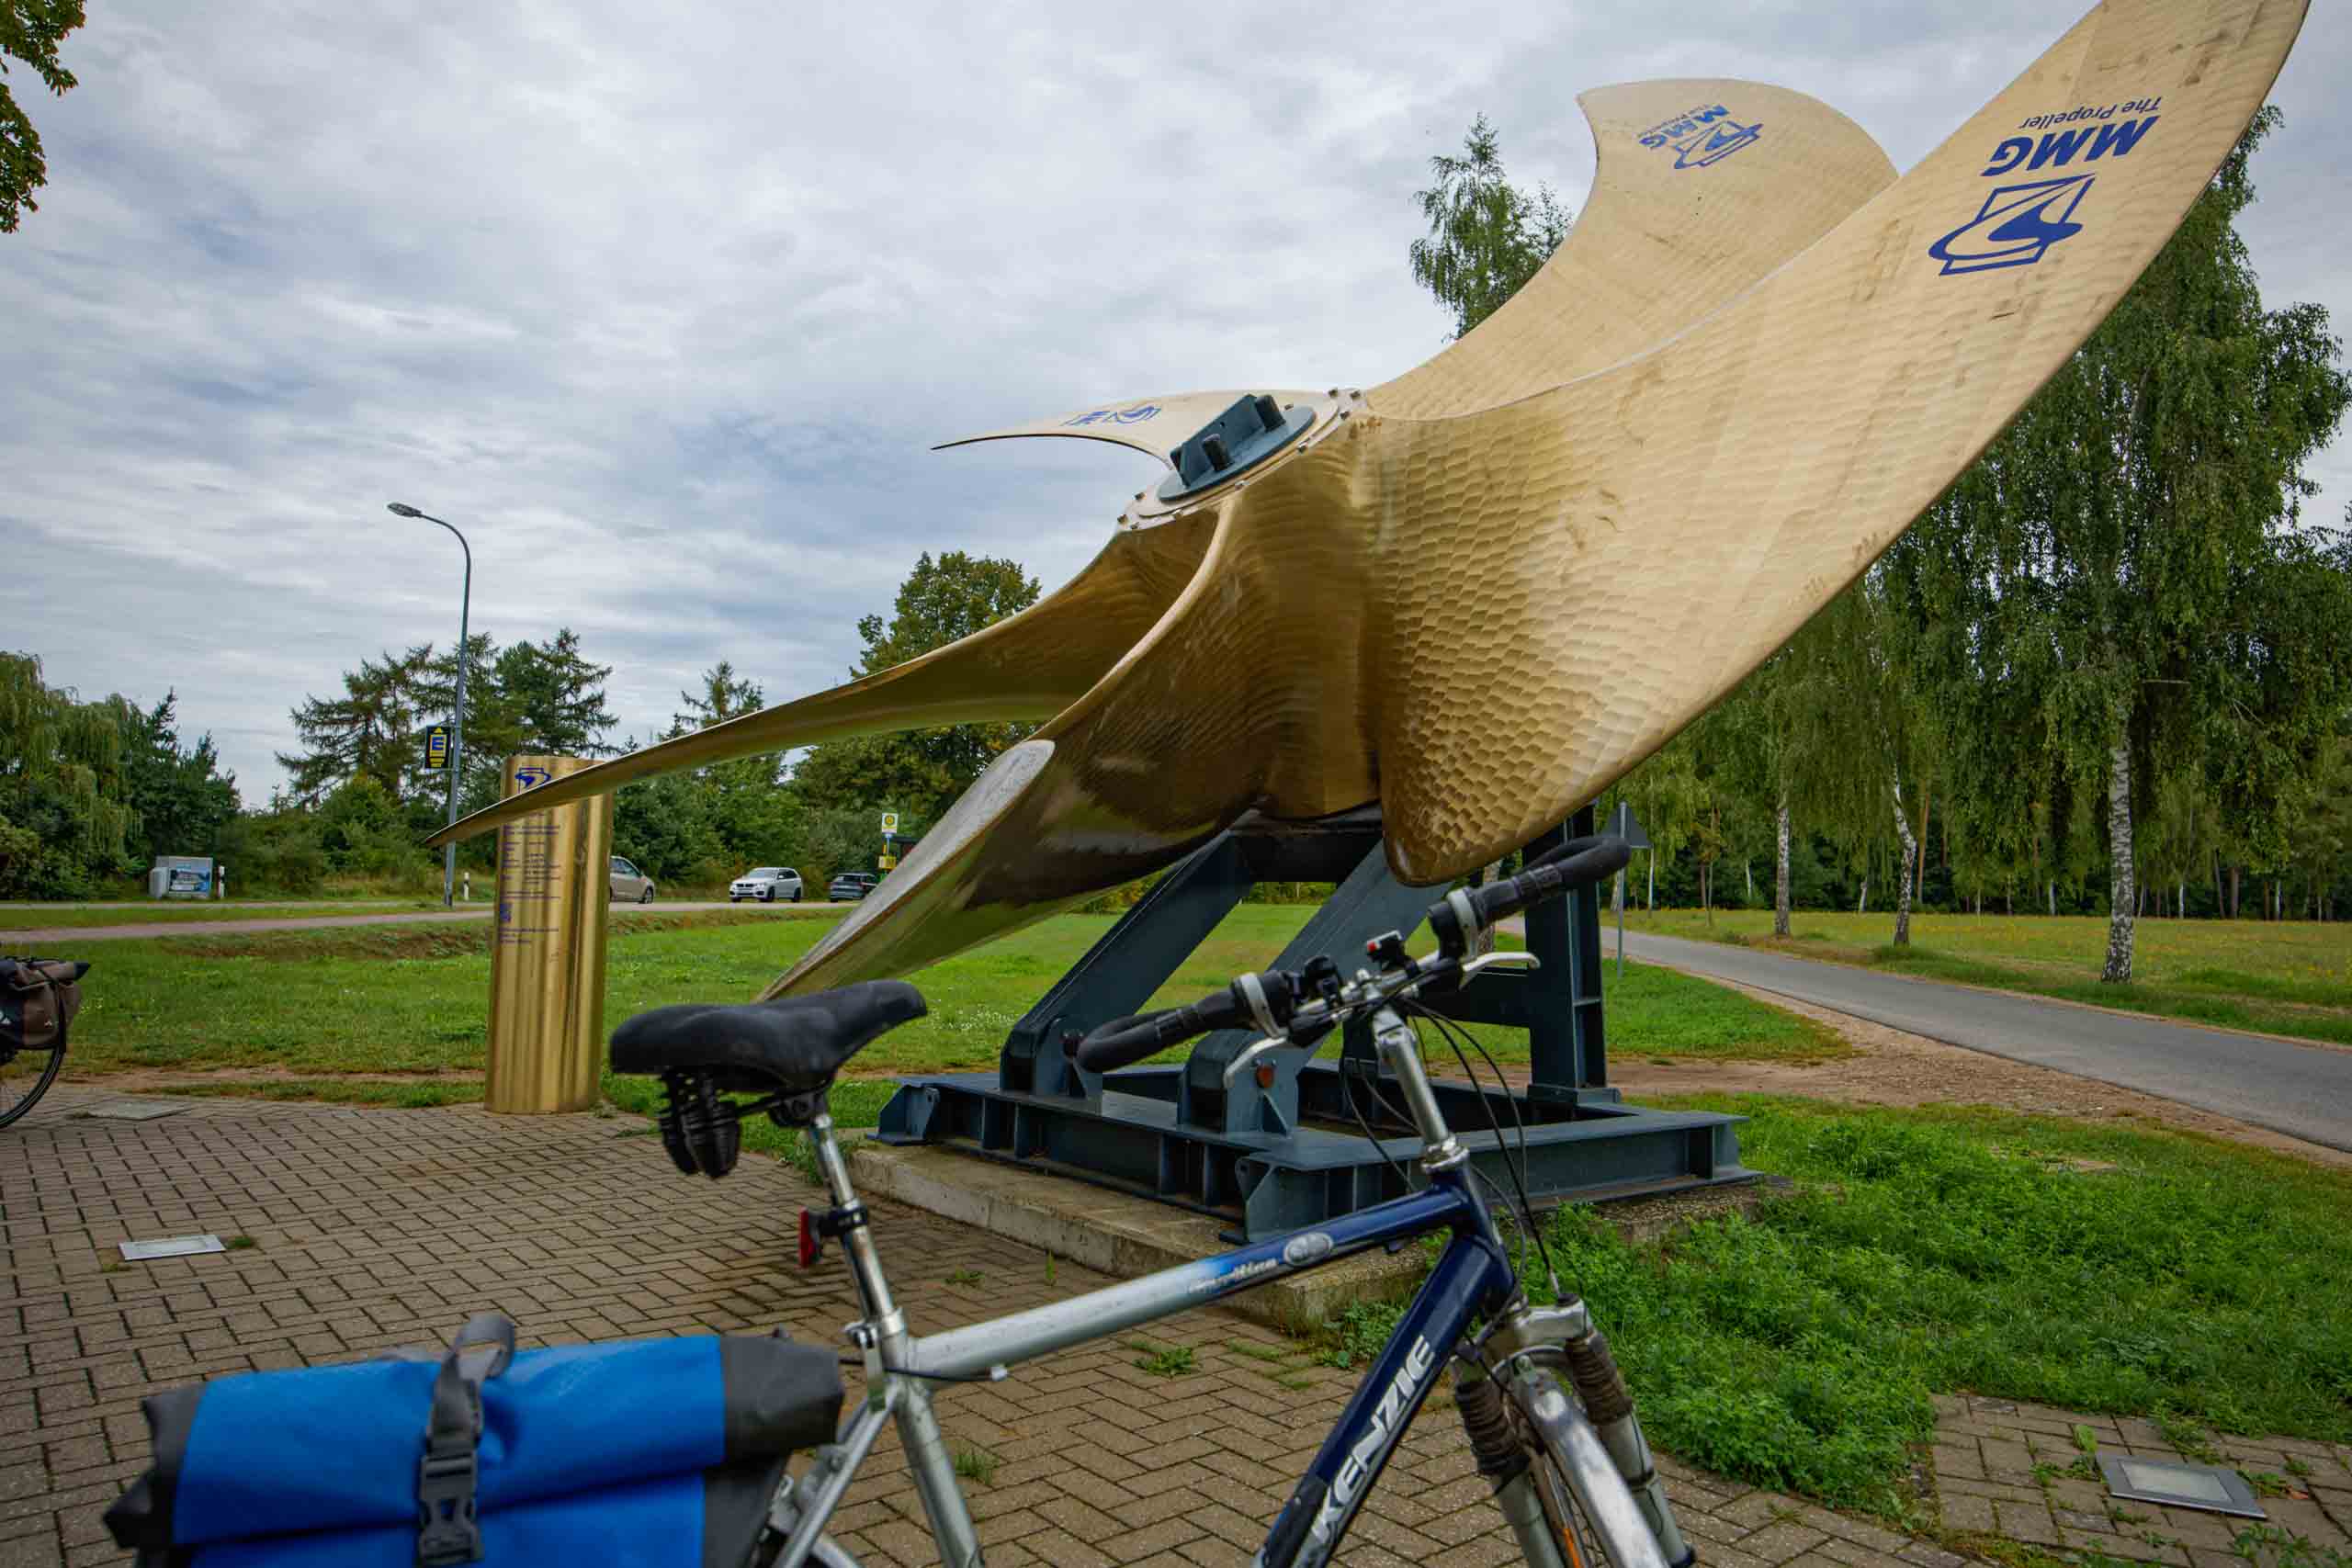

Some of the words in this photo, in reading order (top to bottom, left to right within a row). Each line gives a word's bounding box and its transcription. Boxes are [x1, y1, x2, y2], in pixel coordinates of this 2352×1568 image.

[2018, 104, 2118, 130] Propeller
[2121, 96, 2162, 114] The
[1979, 115, 2162, 177] MMG
